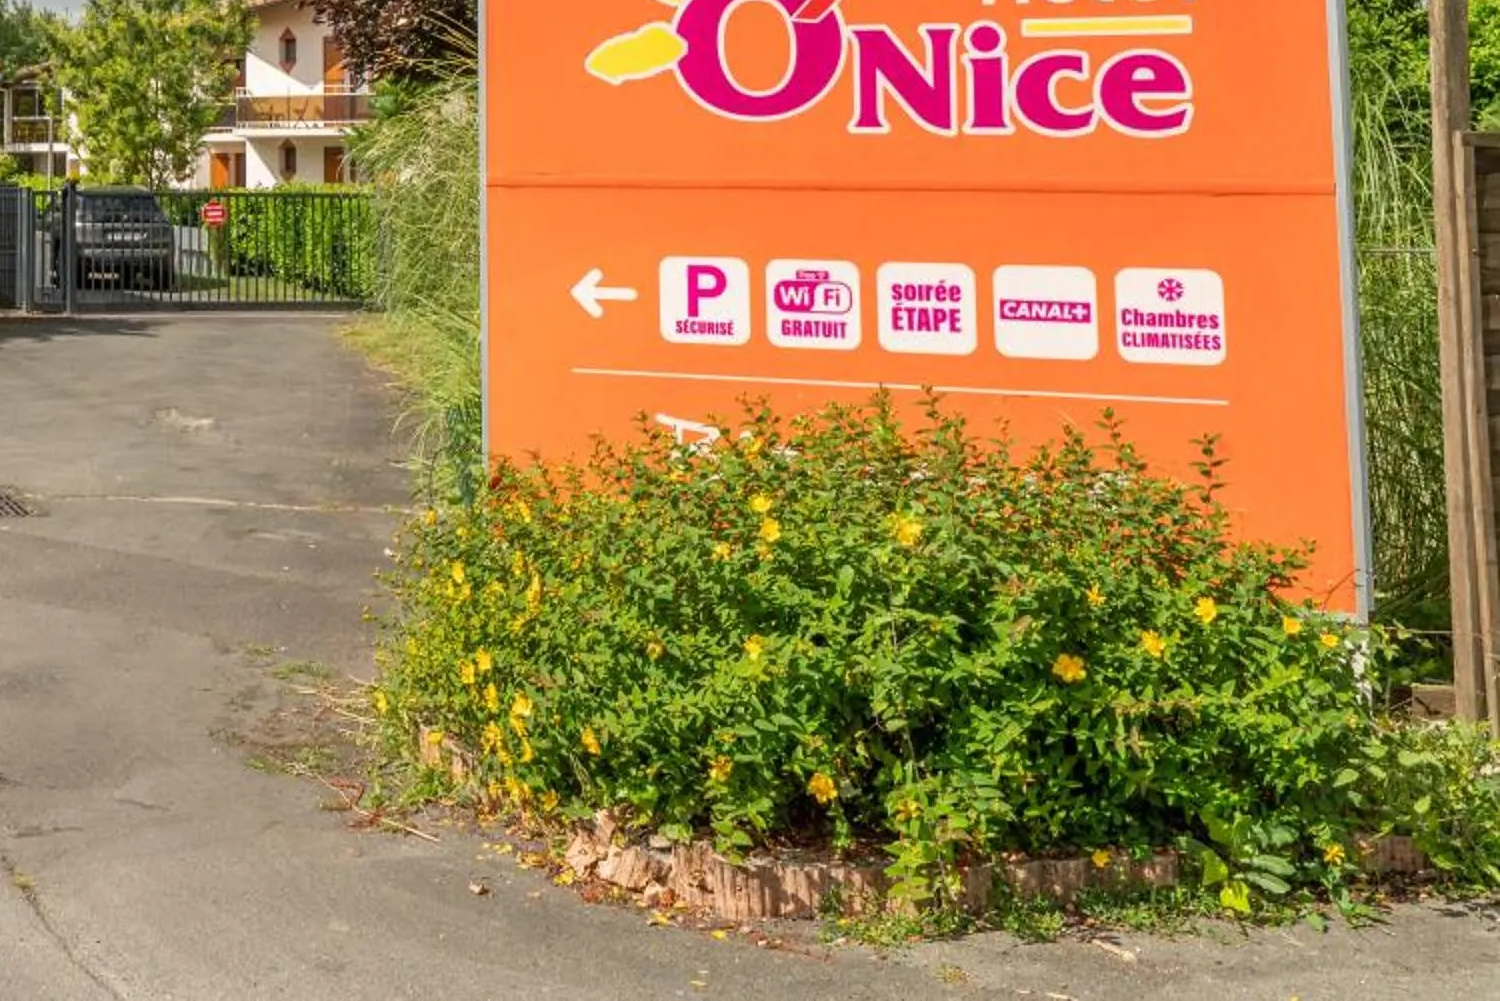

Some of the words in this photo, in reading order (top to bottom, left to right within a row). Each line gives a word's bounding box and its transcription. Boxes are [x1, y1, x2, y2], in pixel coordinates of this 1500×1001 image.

[687, 264, 728, 318] P
[891, 280, 961, 303] soirée
[891, 303, 962, 333] ÉTAPE
[1002, 302, 1089, 321] CANAL+
[1120, 307, 1220, 331] Chambres
[675, 318, 734, 336] SÉCURISÉ
[781, 318, 848, 340] GRATUIT
[1121, 330, 1221, 352] CLIMATISÉES
